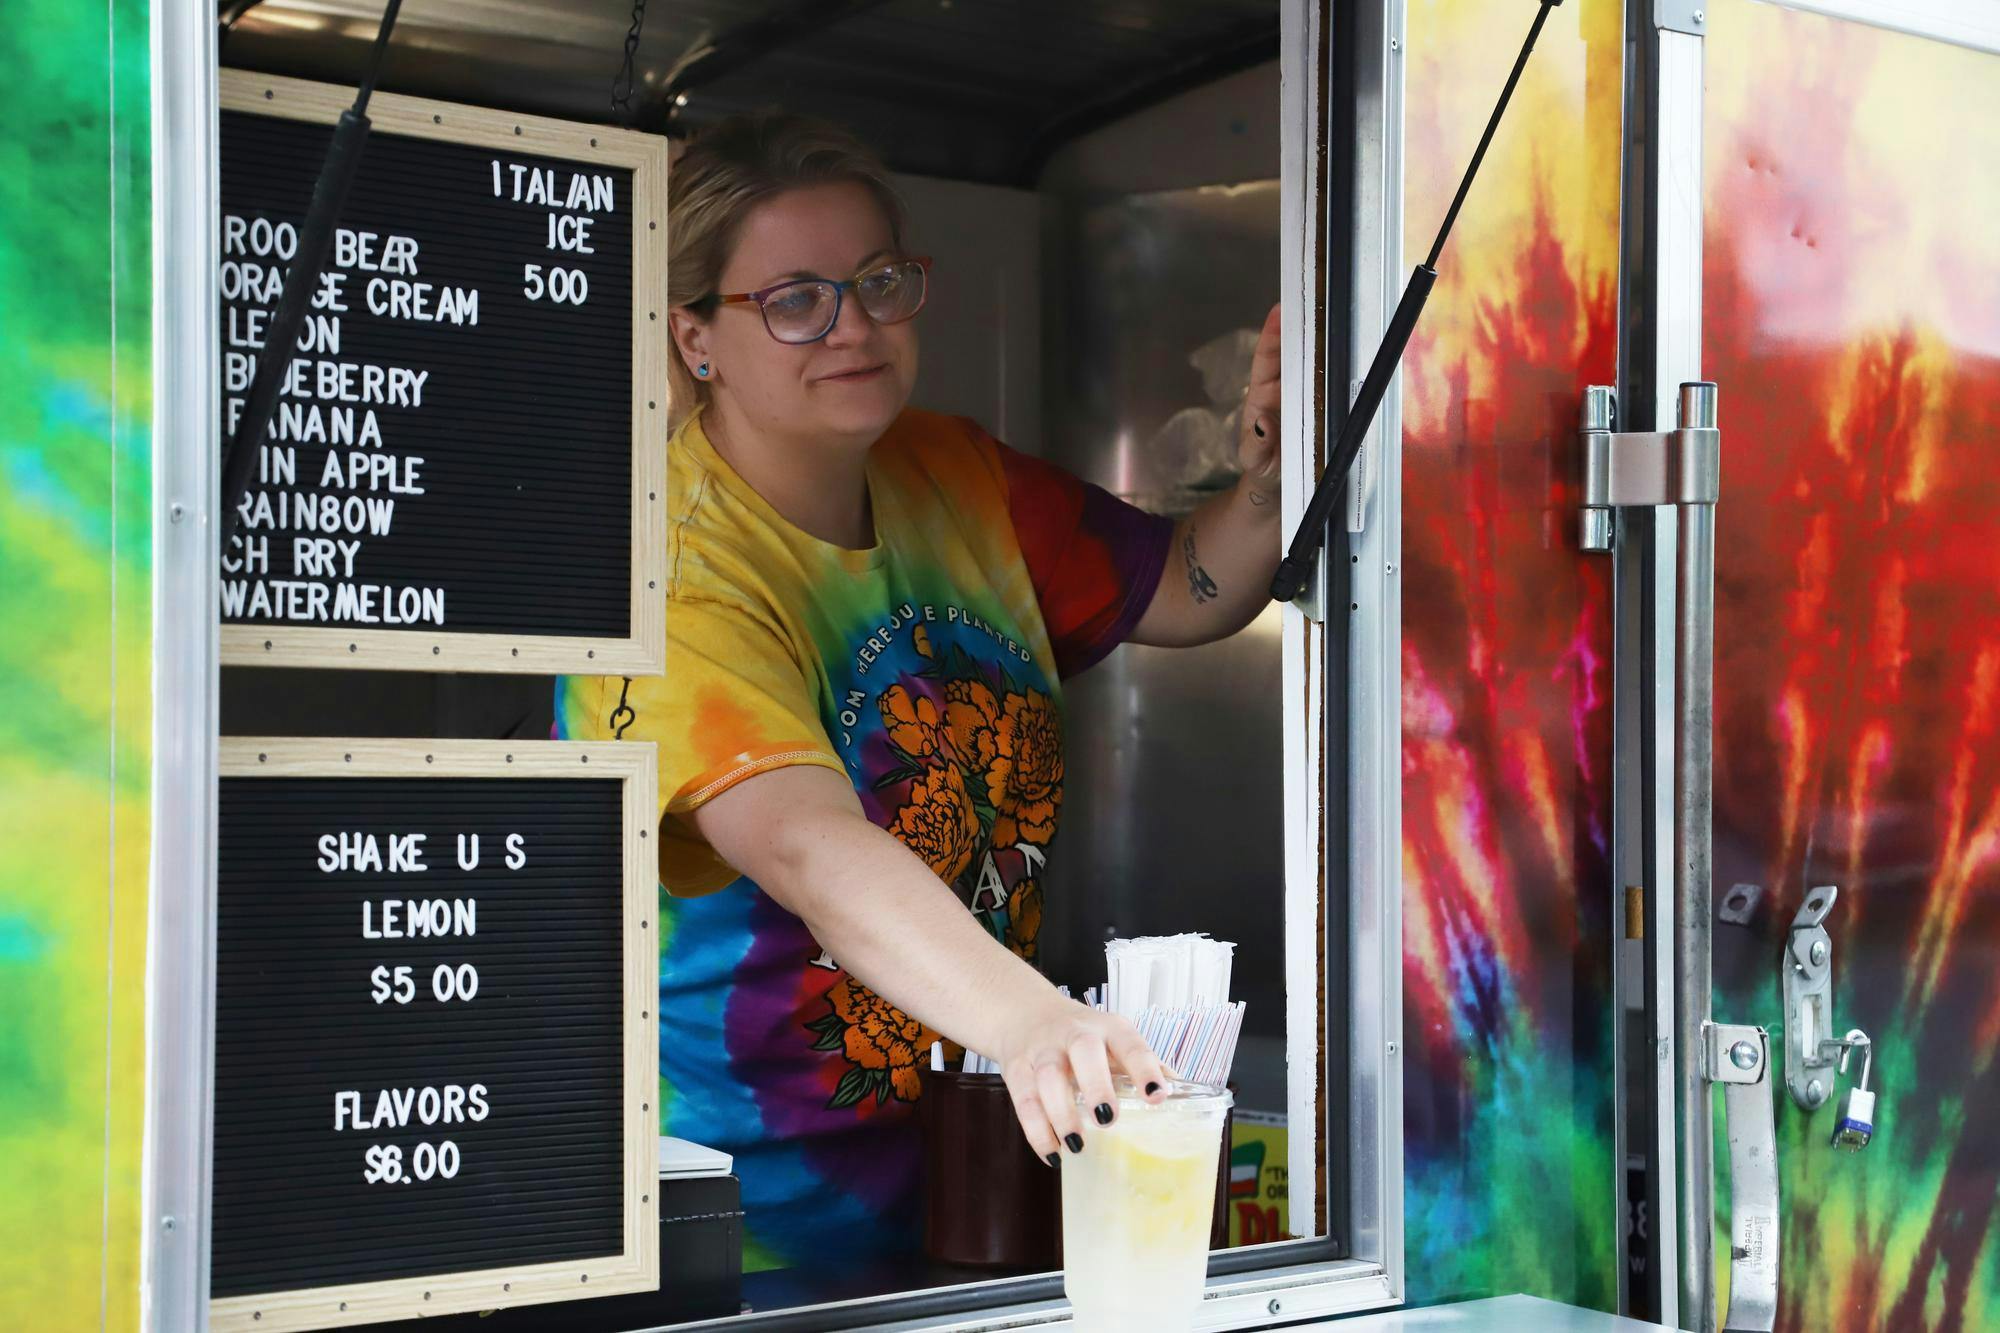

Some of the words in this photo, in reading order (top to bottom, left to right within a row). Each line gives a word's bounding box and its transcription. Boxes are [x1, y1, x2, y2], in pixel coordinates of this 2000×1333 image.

[492, 160, 614, 213] ITALIAN
[546, 213, 594, 254] ICE
[220, 261, 348, 312] ORAGE
[366, 277, 478, 327] CREAM
[229, 306, 340, 355] LEON
[319, 449, 425, 495] APPLE
[293, 537, 361, 578] RRY
[220, 579, 445, 626] WATERMELON
[947, 606, 1031, 662] PLANTED
[317, 832, 428, 873] SHAKE
[363, 898, 476, 939] LEMON
[334, 1083, 490, 1131] FLAVORS
[364, 1140, 461, 1184] $6.00
